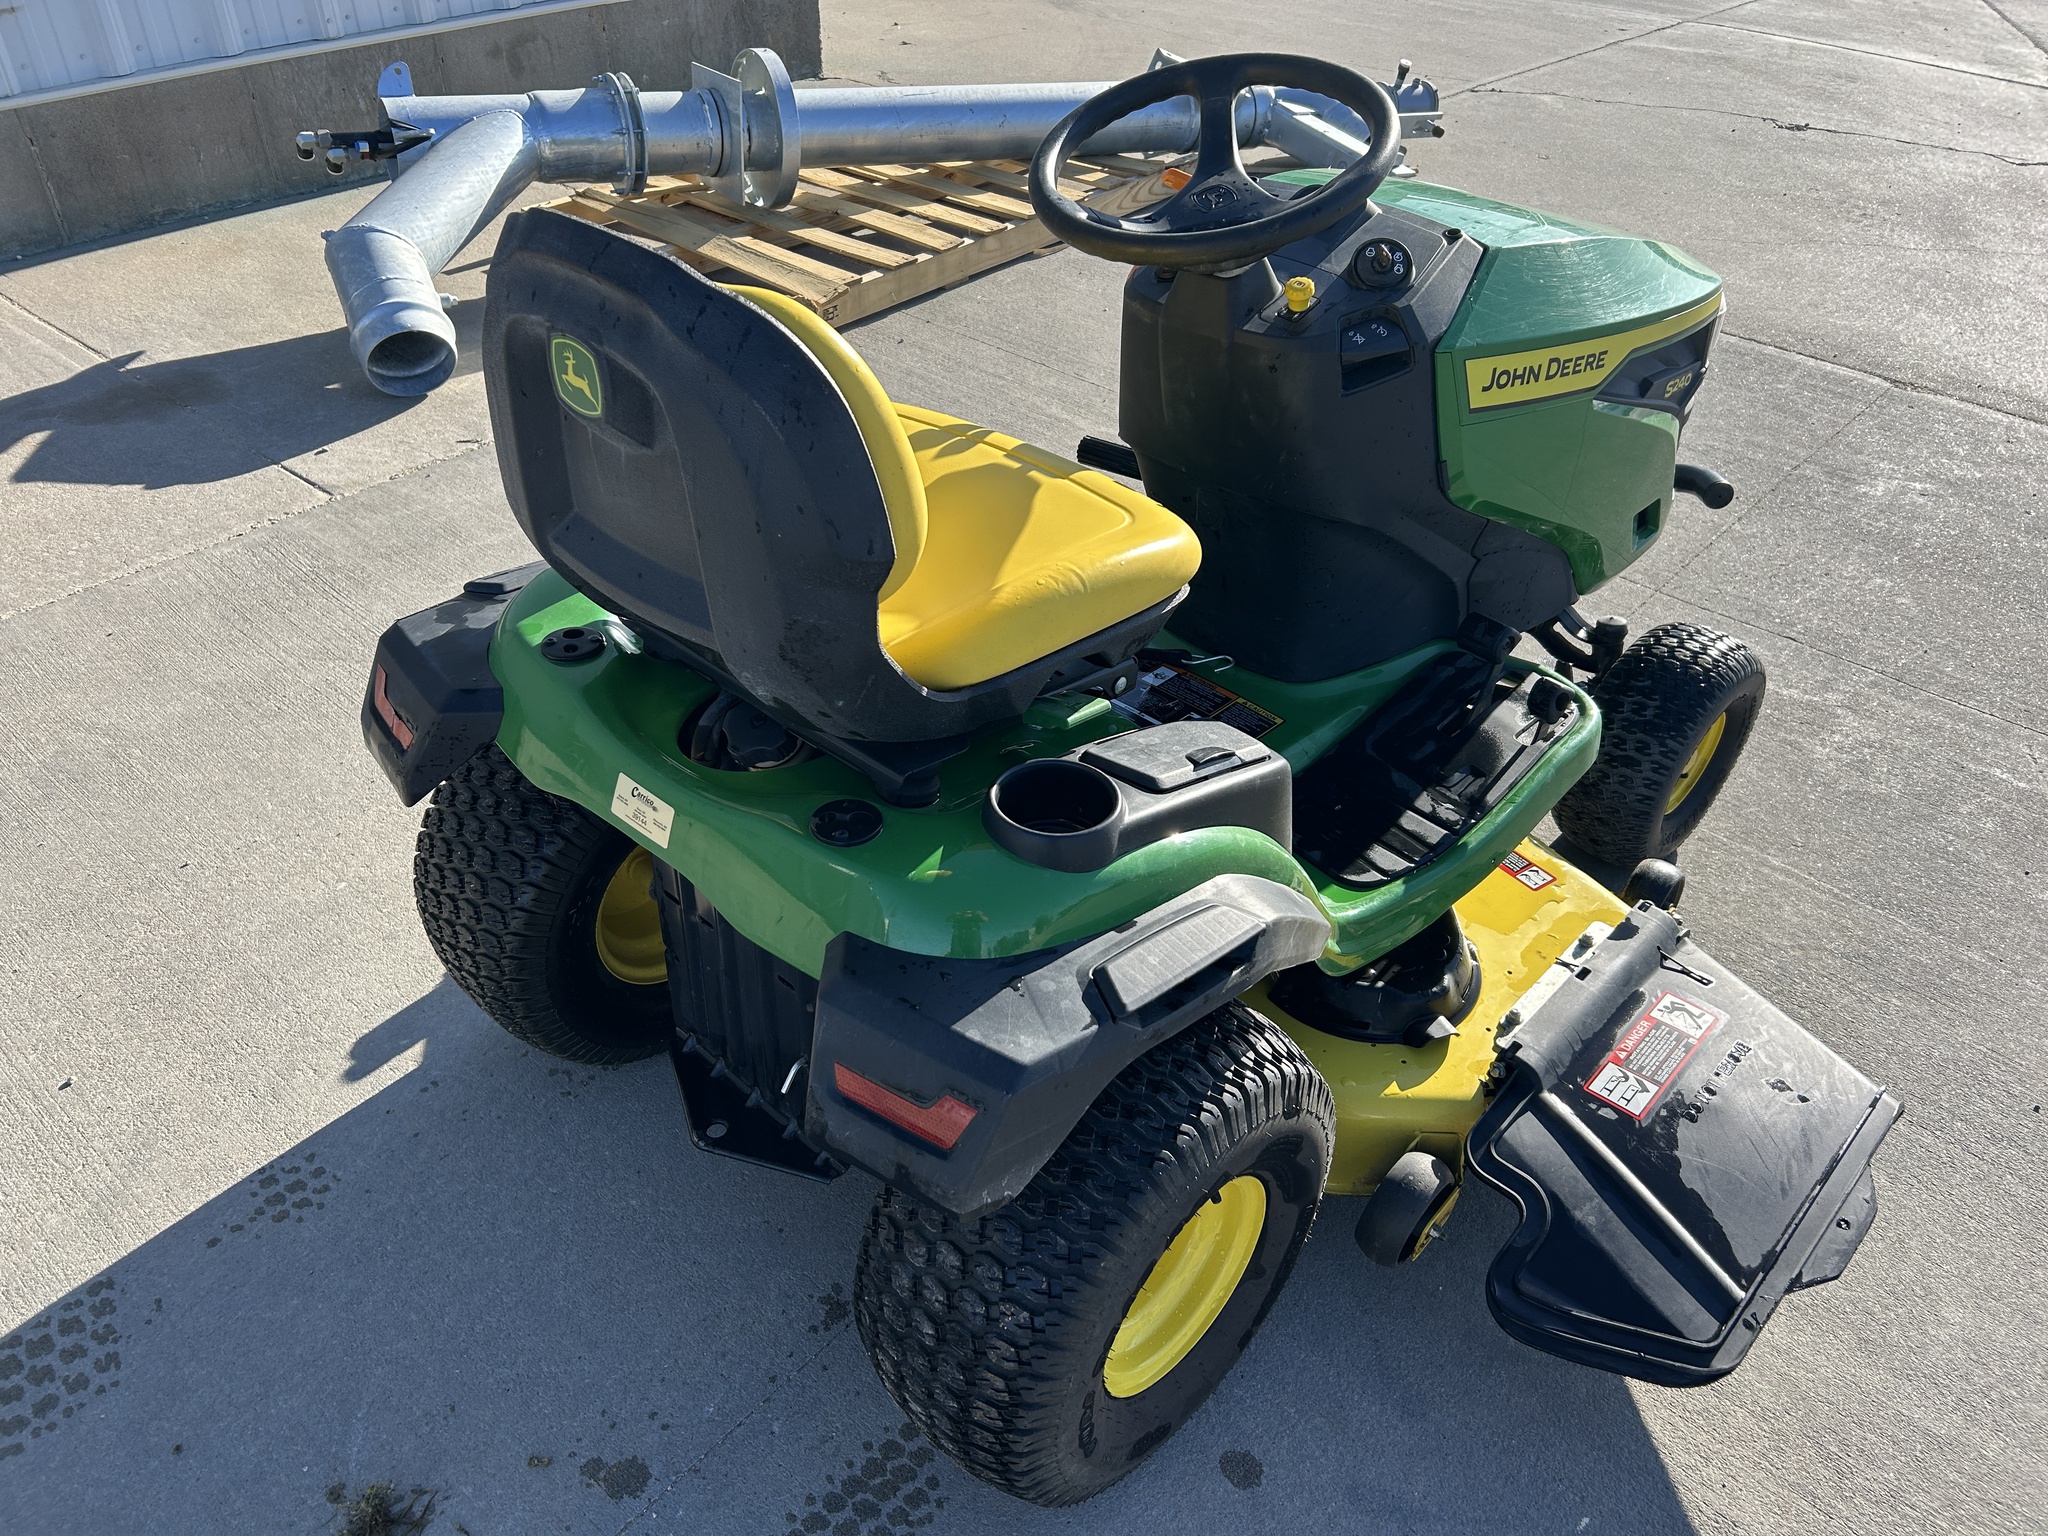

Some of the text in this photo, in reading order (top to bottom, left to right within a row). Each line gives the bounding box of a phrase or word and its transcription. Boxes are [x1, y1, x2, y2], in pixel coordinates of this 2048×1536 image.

[1481, 350, 1609, 392] JOHN DEERE
[1664, 372, 1693, 398] S240
[1247, 703, 1278, 721] CAUTION
[631, 786, 655, 807] Carrico
[1625, 1020, 1652, 1051] DANGER
[1694, 1079, 1721, 1105] NOT
